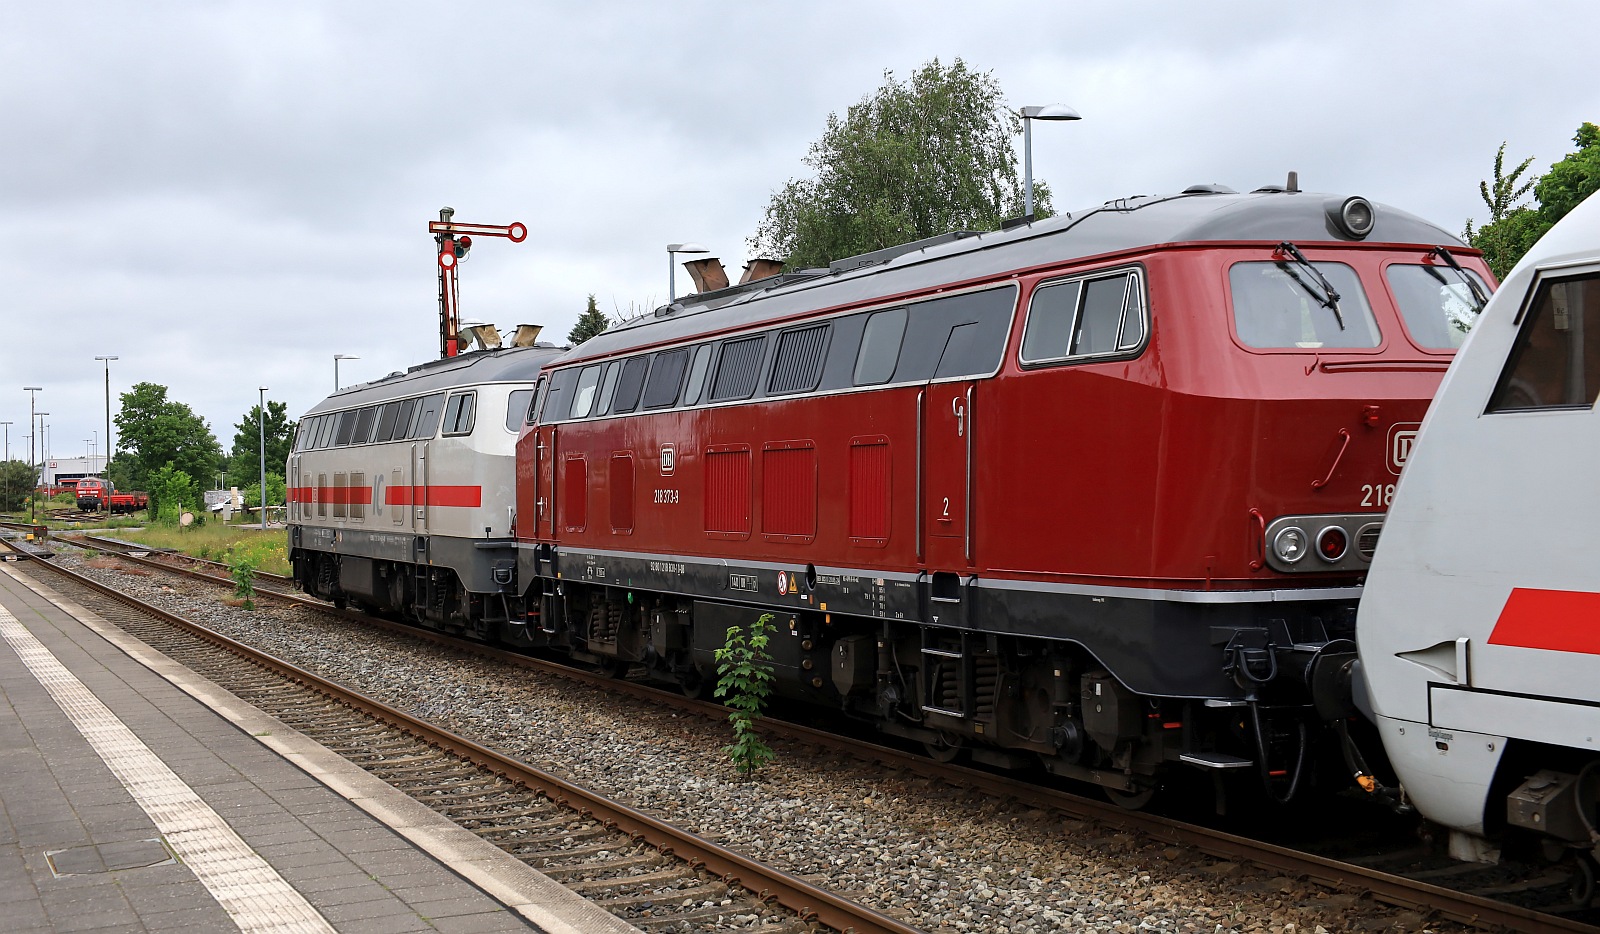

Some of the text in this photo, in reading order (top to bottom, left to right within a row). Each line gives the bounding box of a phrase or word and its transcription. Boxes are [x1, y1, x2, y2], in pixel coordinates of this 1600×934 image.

[663, 452, 672, 467] DB
[373, 474, 384, 516] IC
[654, 489, 679, 504] 218 373-9
[1360, 484, 1396, 507] 218
[943, 497, 949, 516] 2
[1428, 727, 1454, 743] Bugklappe
